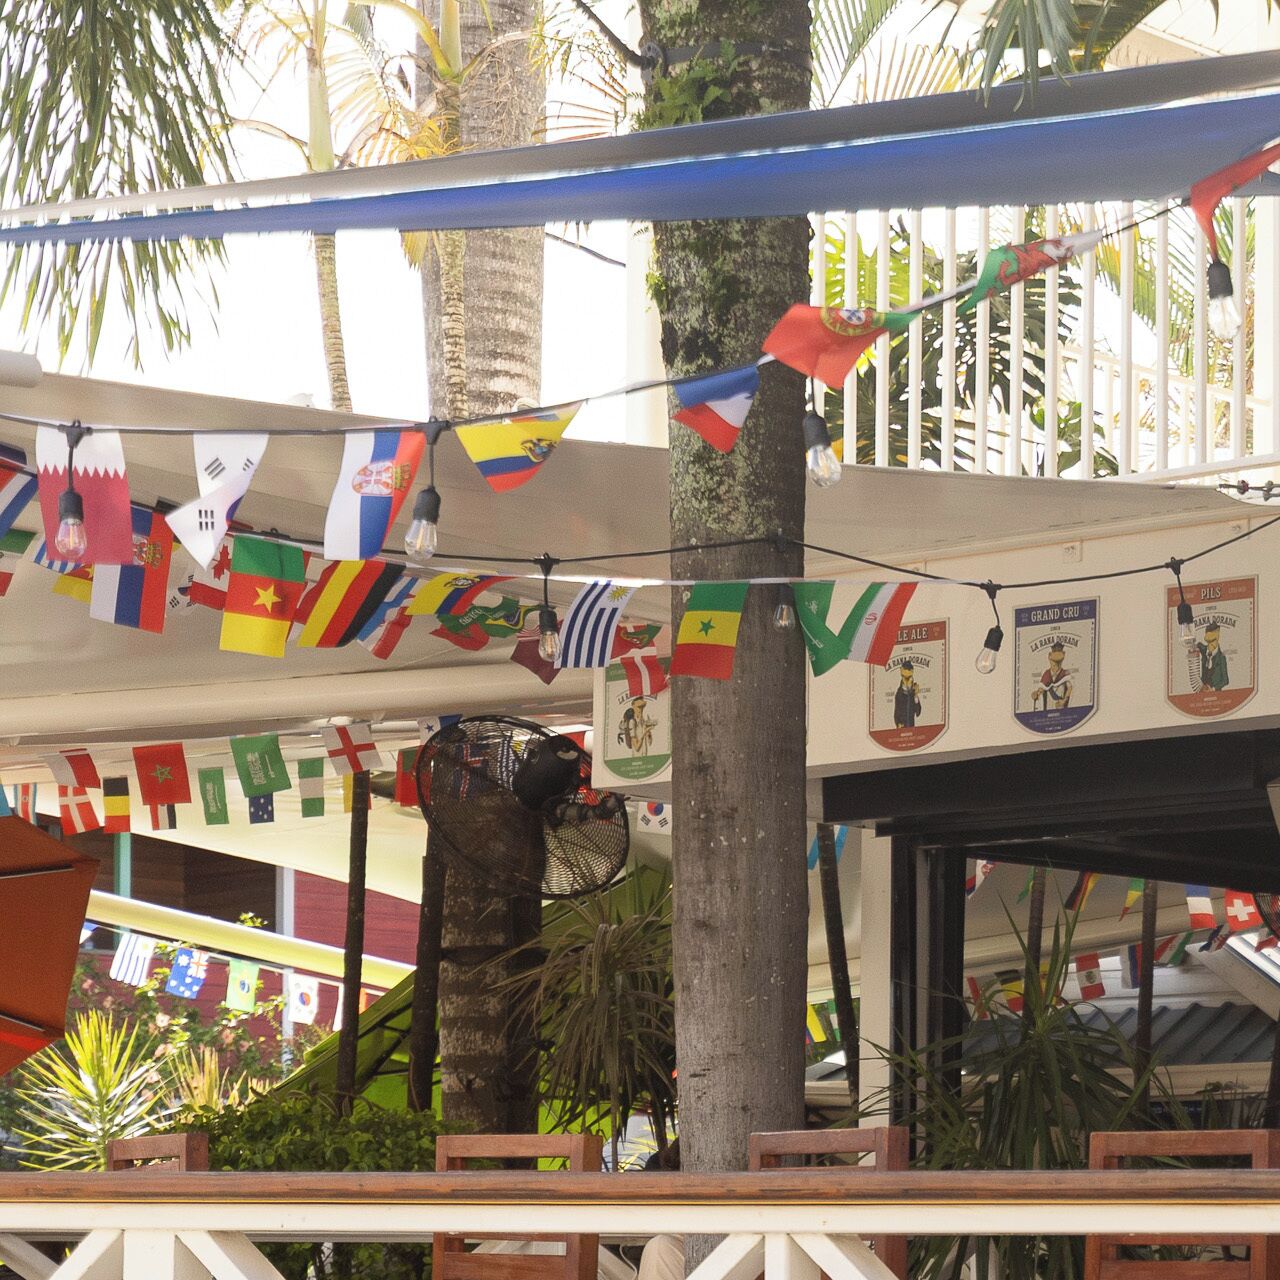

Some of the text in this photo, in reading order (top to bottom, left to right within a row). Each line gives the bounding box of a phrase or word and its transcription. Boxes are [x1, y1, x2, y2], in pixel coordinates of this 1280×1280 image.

[1201, 587, 1221, 600] PILS
[1030, 608, 1060, 622] GRAND
[1062, 606, 1080, 618] CRU
[911, 627, 928, 640] ALE
[1030, 643, 1039, 652] LA
